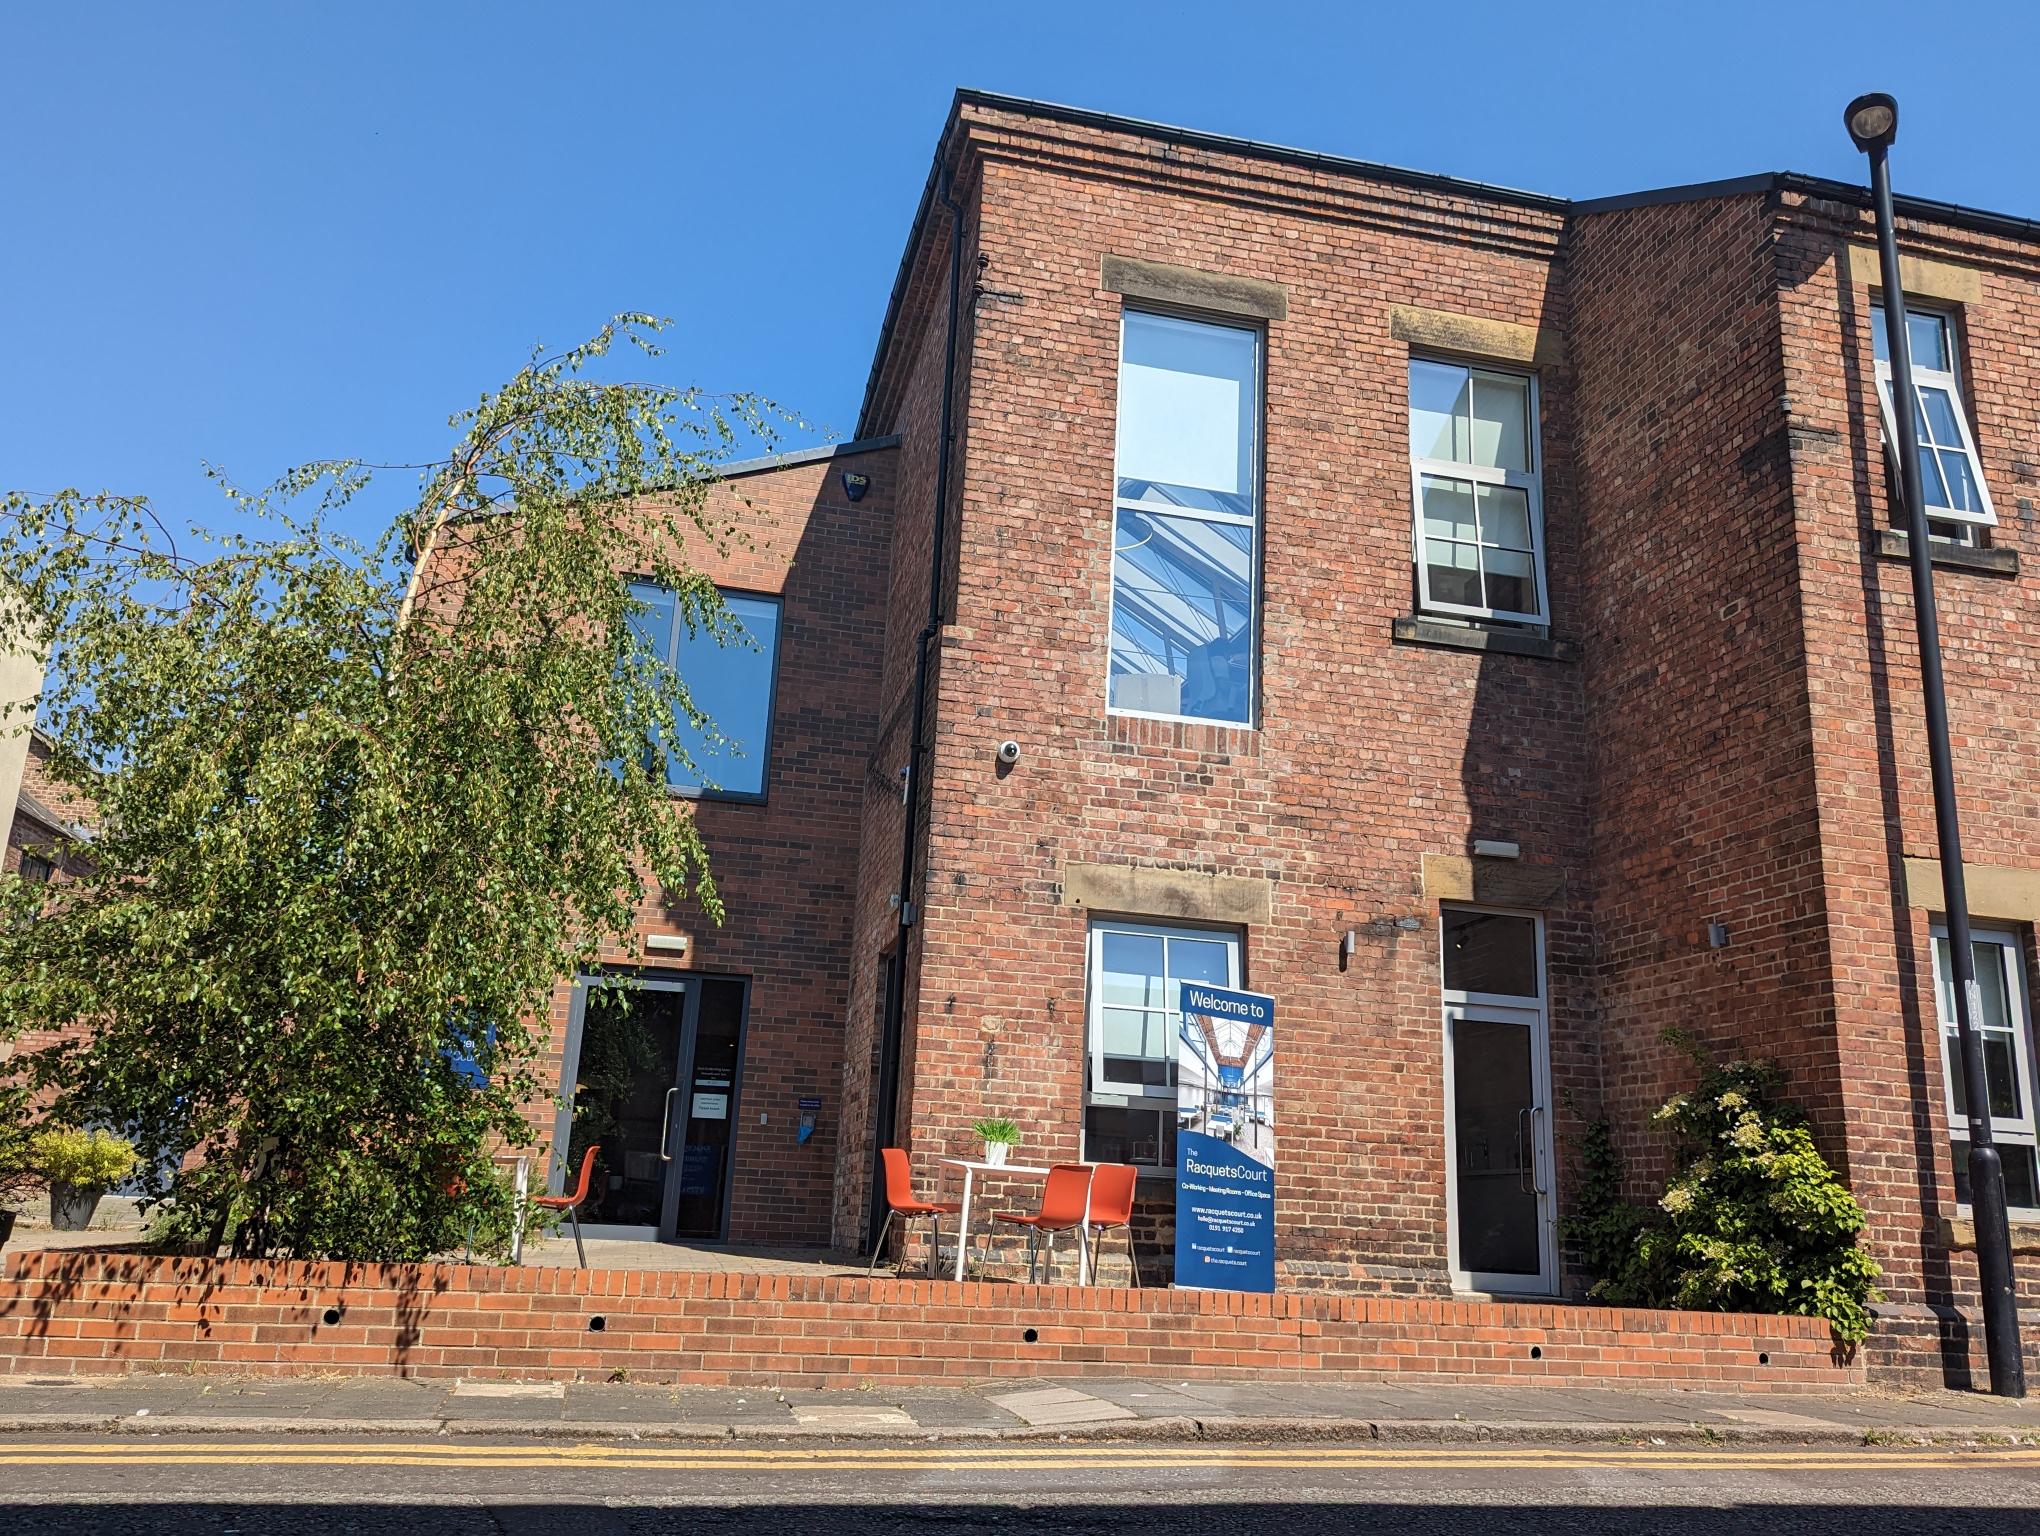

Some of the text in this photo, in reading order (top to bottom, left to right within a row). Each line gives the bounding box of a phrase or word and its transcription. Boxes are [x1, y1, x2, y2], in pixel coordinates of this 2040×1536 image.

[1189, 990, 1264, 1018] Welcome to
[1187, 1148, 1198, 1156] The
[1186, 1159, 1267, 1181] RacquetsCourt
[1192, 1207, 1262, 1219] www.racquetscourt.co.uk
